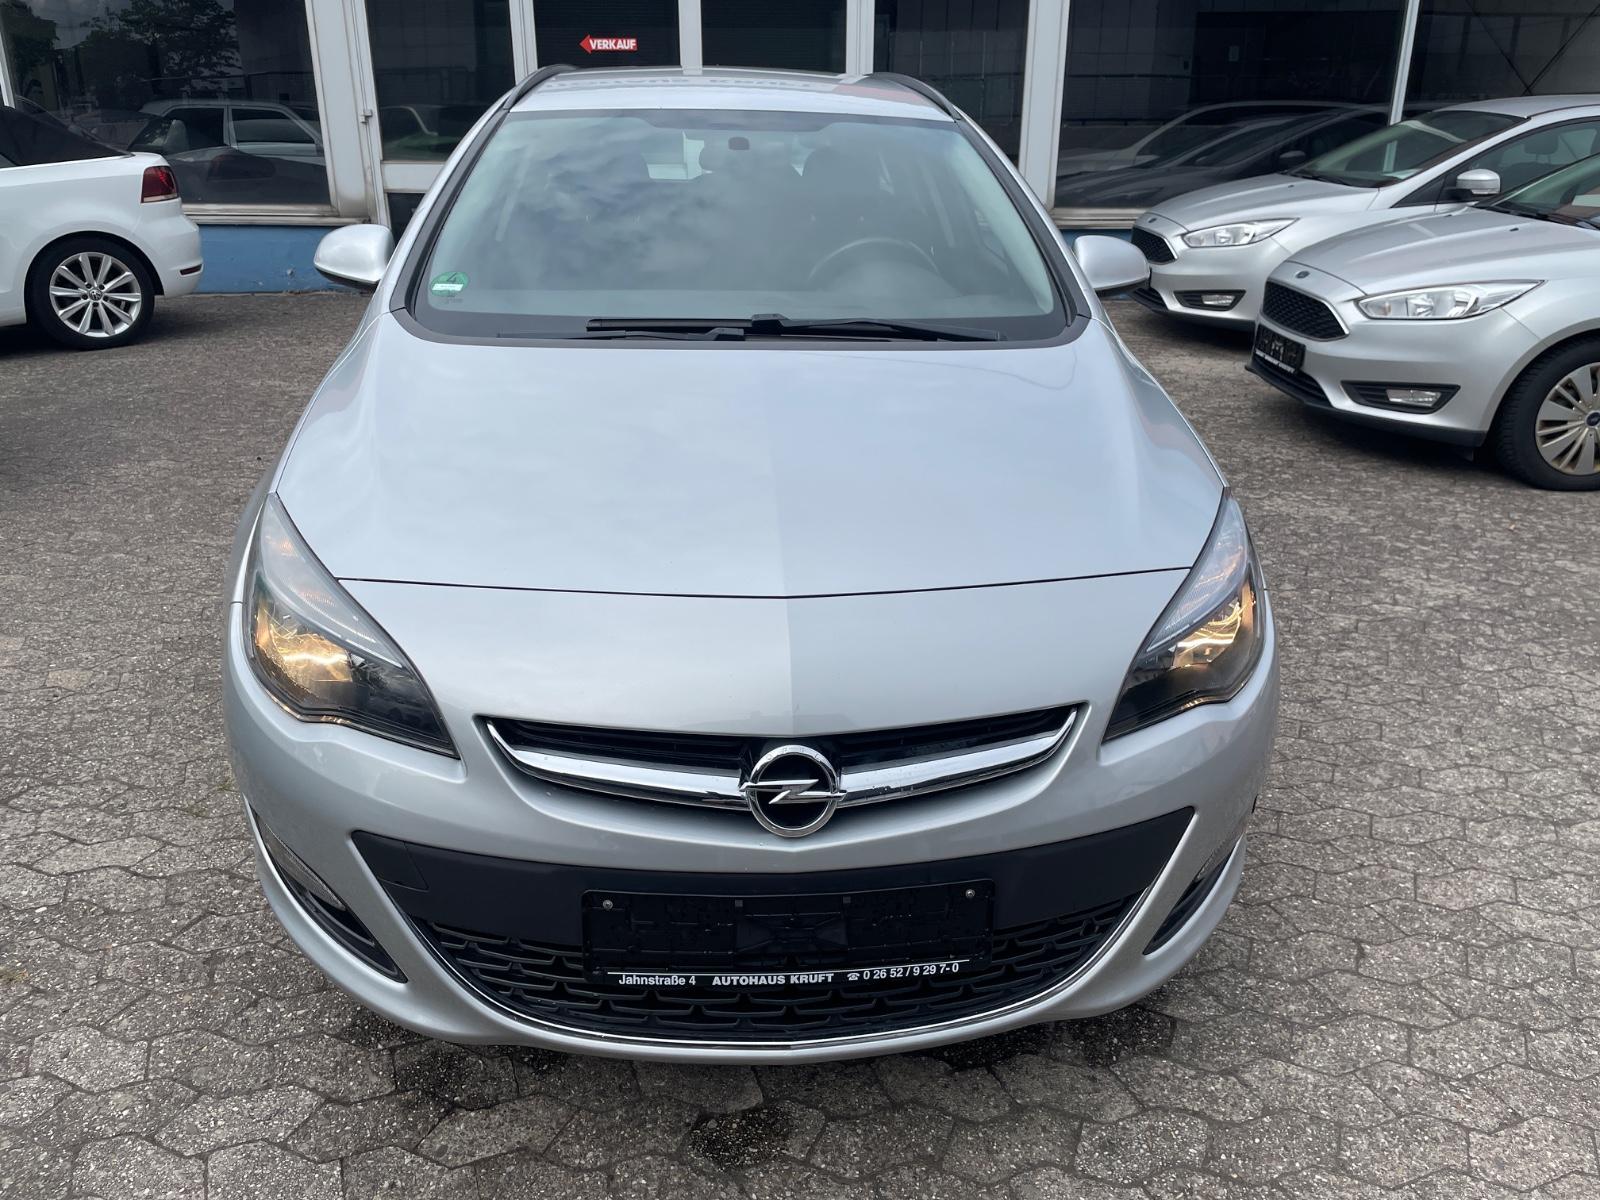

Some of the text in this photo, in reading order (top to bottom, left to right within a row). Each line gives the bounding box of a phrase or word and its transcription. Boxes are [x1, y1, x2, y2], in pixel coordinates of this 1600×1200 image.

[589, 38, 637, 50] VERKAUF
[618, 974, 686, 986] Jahnstraße
[688, 974, 696, 985] 4
[712, 975, 786, 986] AUTOHAUS
[790, 972, 834, 984] KRUFT
